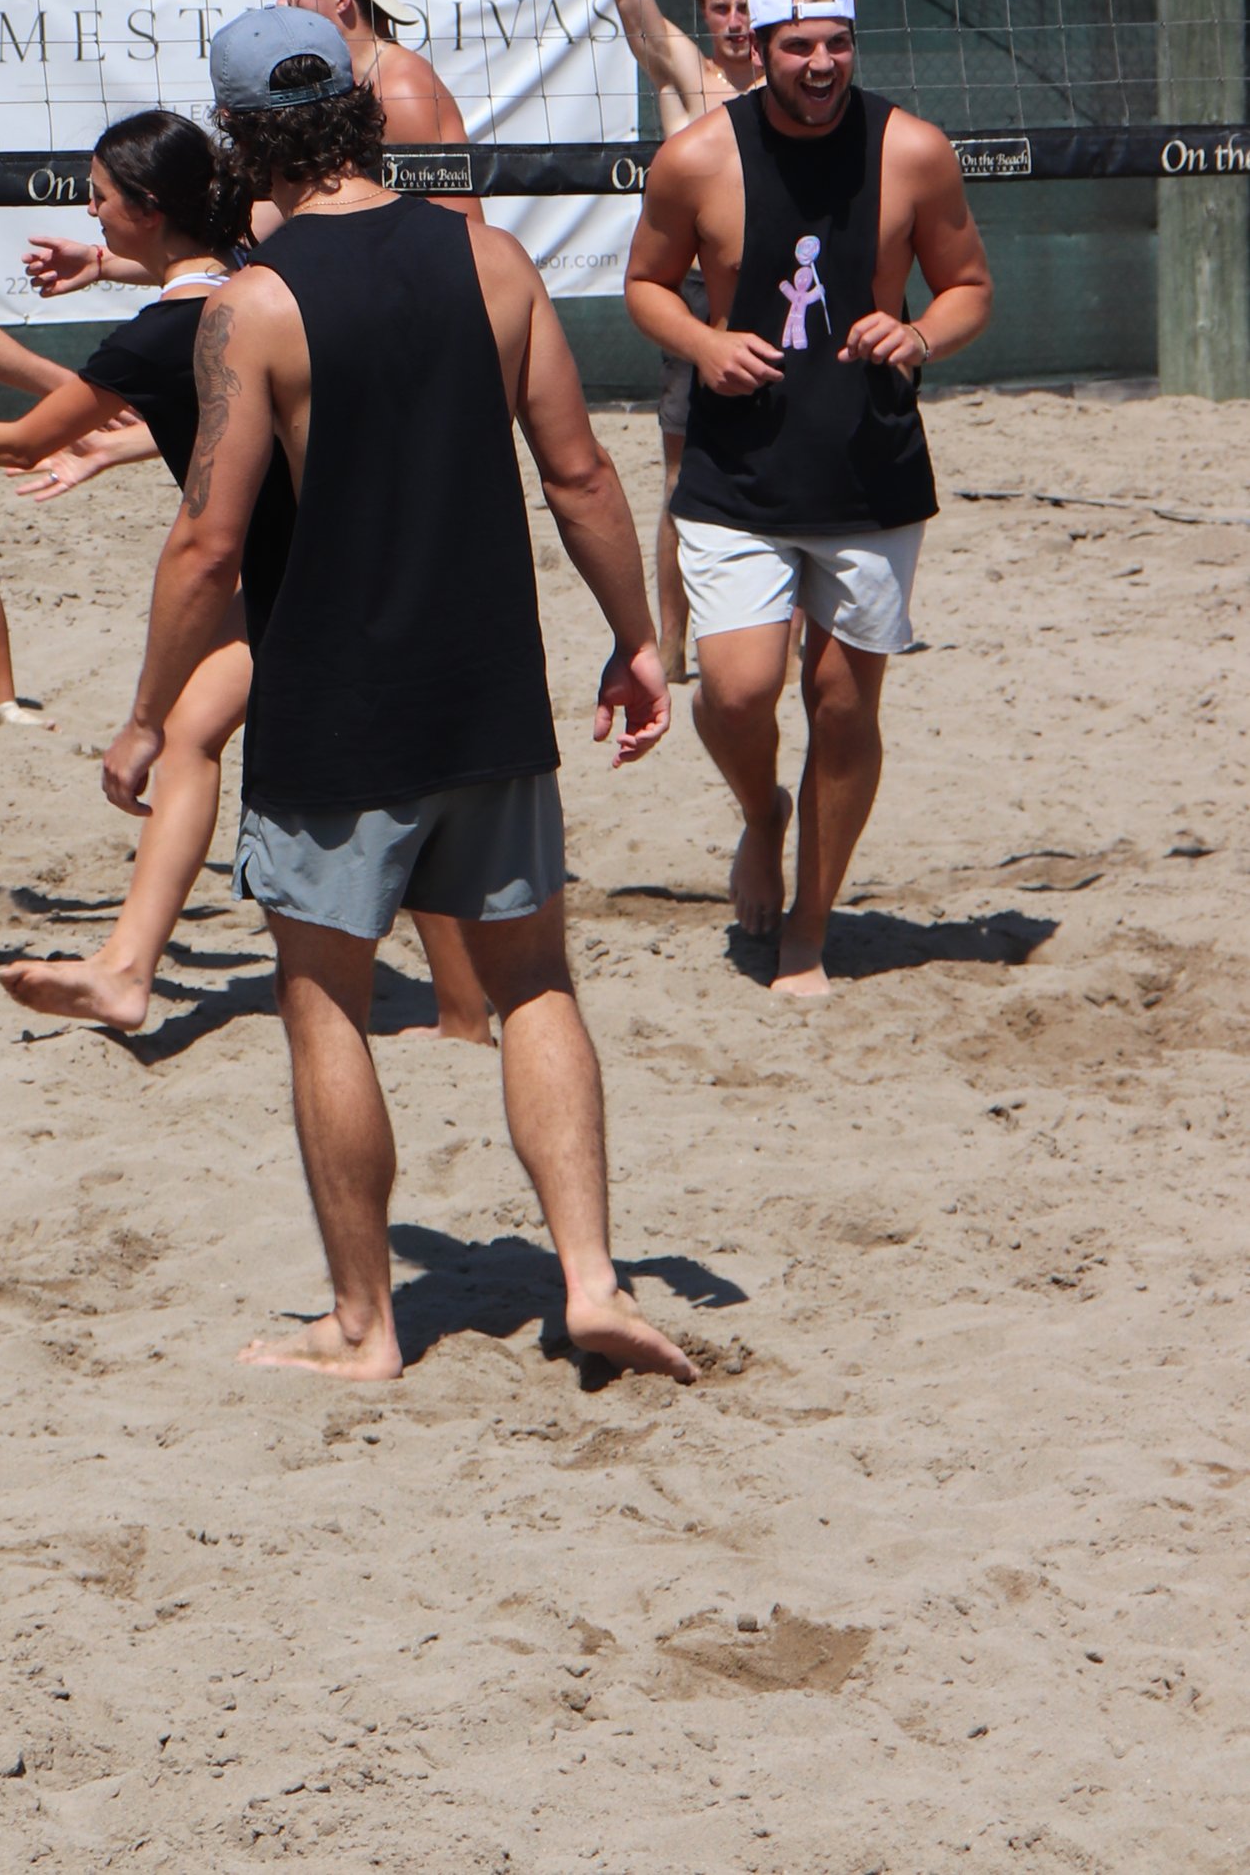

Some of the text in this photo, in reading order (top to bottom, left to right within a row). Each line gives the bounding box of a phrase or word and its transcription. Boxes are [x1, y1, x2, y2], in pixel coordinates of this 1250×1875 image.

[996, 150, 1028, 166] Beach
[1161, 139, 1209, 173] On
[28, 168, 78, 201] On
[400, 166, 469, 181] On the Beach
